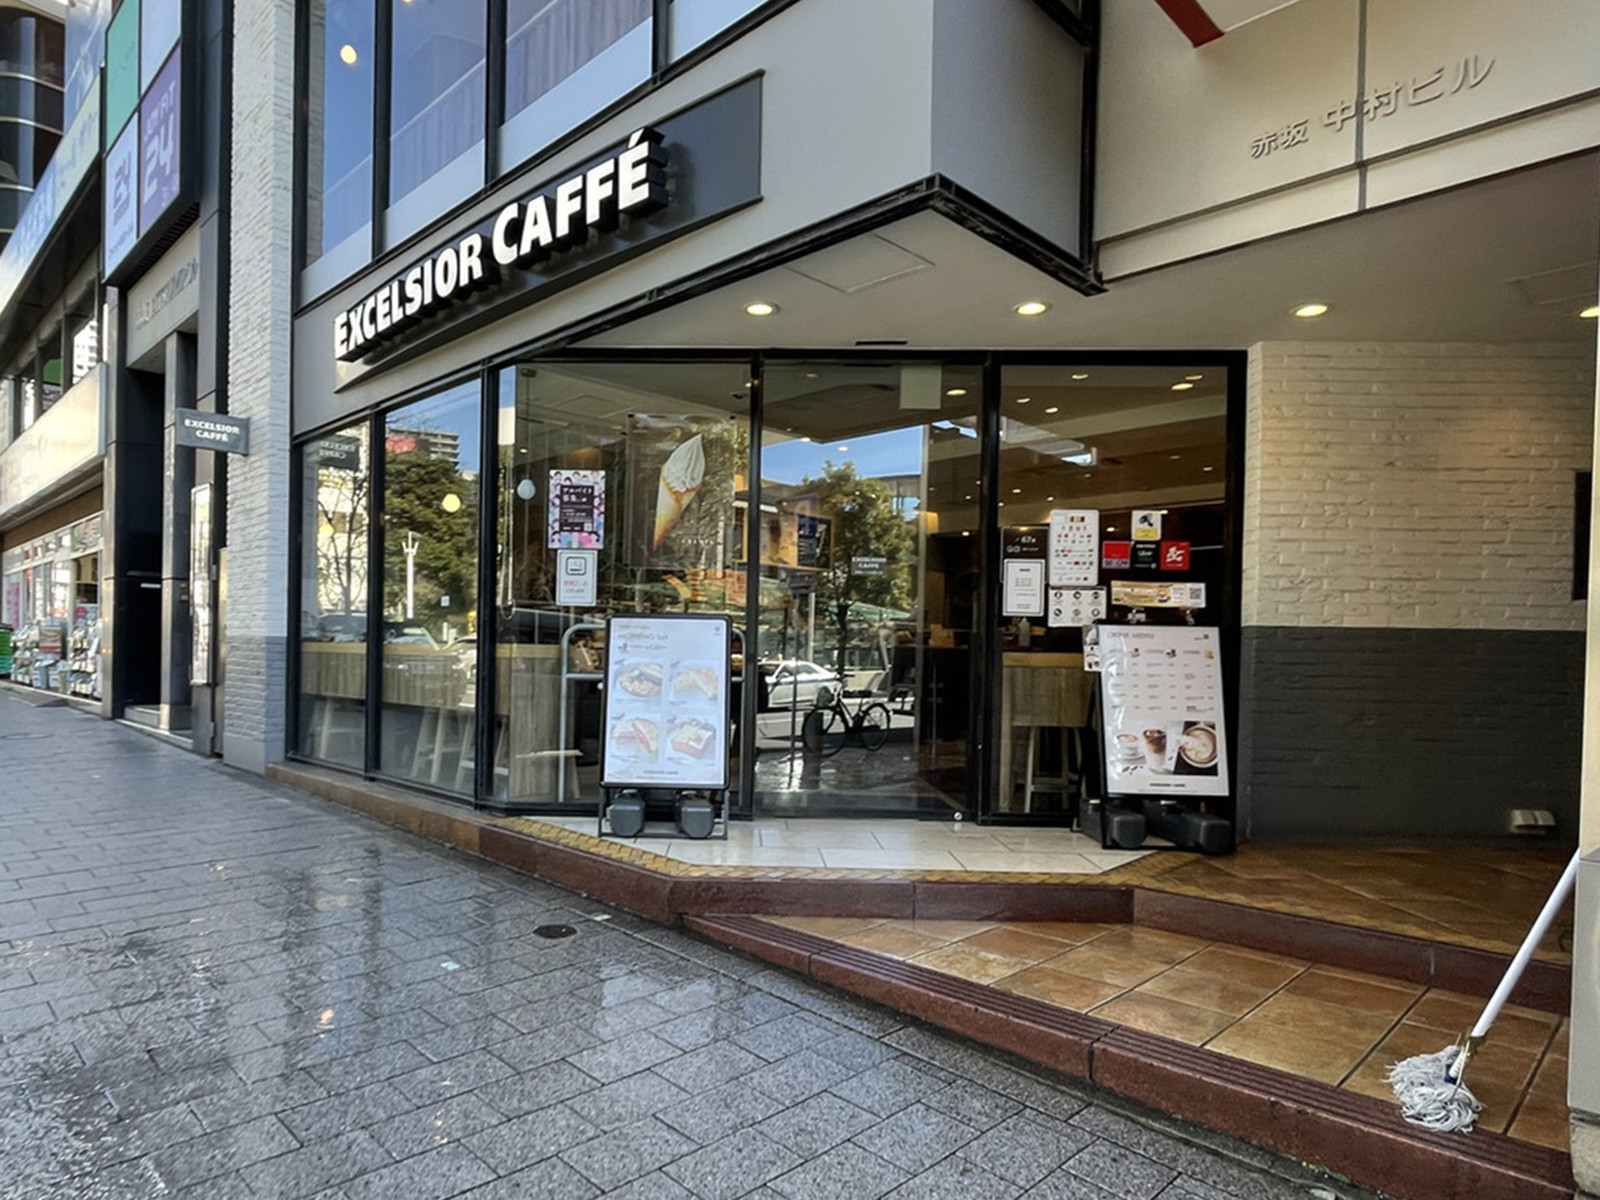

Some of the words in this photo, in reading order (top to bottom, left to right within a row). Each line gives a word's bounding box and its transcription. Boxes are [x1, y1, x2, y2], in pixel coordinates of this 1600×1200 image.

[1251, 119, 1310, 158] 赤坂
[1322, 55, 1496, 132] 中村ビル
[333, 232, 484, 355] EXCELSIOR
[491, 127, 651, 265] CAFFÉ
[184, 418, 240, 435] EXCELSIOR
